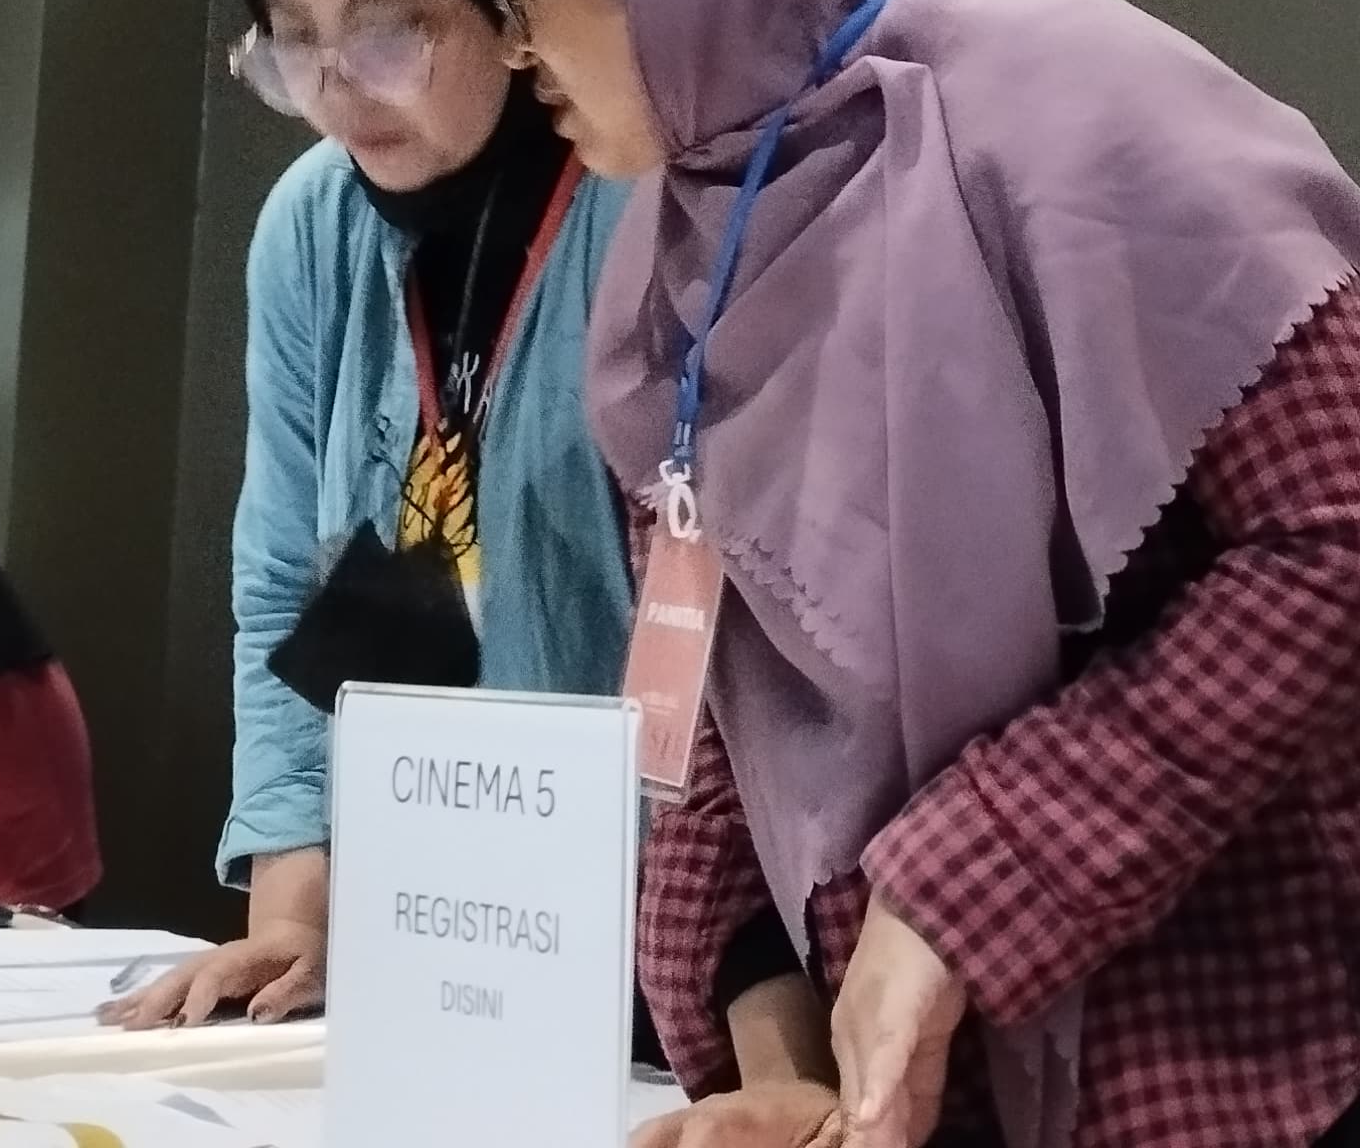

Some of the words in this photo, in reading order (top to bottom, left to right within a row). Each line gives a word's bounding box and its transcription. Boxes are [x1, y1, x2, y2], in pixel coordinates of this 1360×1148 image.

[392, 755, 525, 816] CINEMA
[536, 769, 556, 819] 5
[395, 891, 561, 956] REGISTRASI
[440, 980, 504, 1022] DISINI
